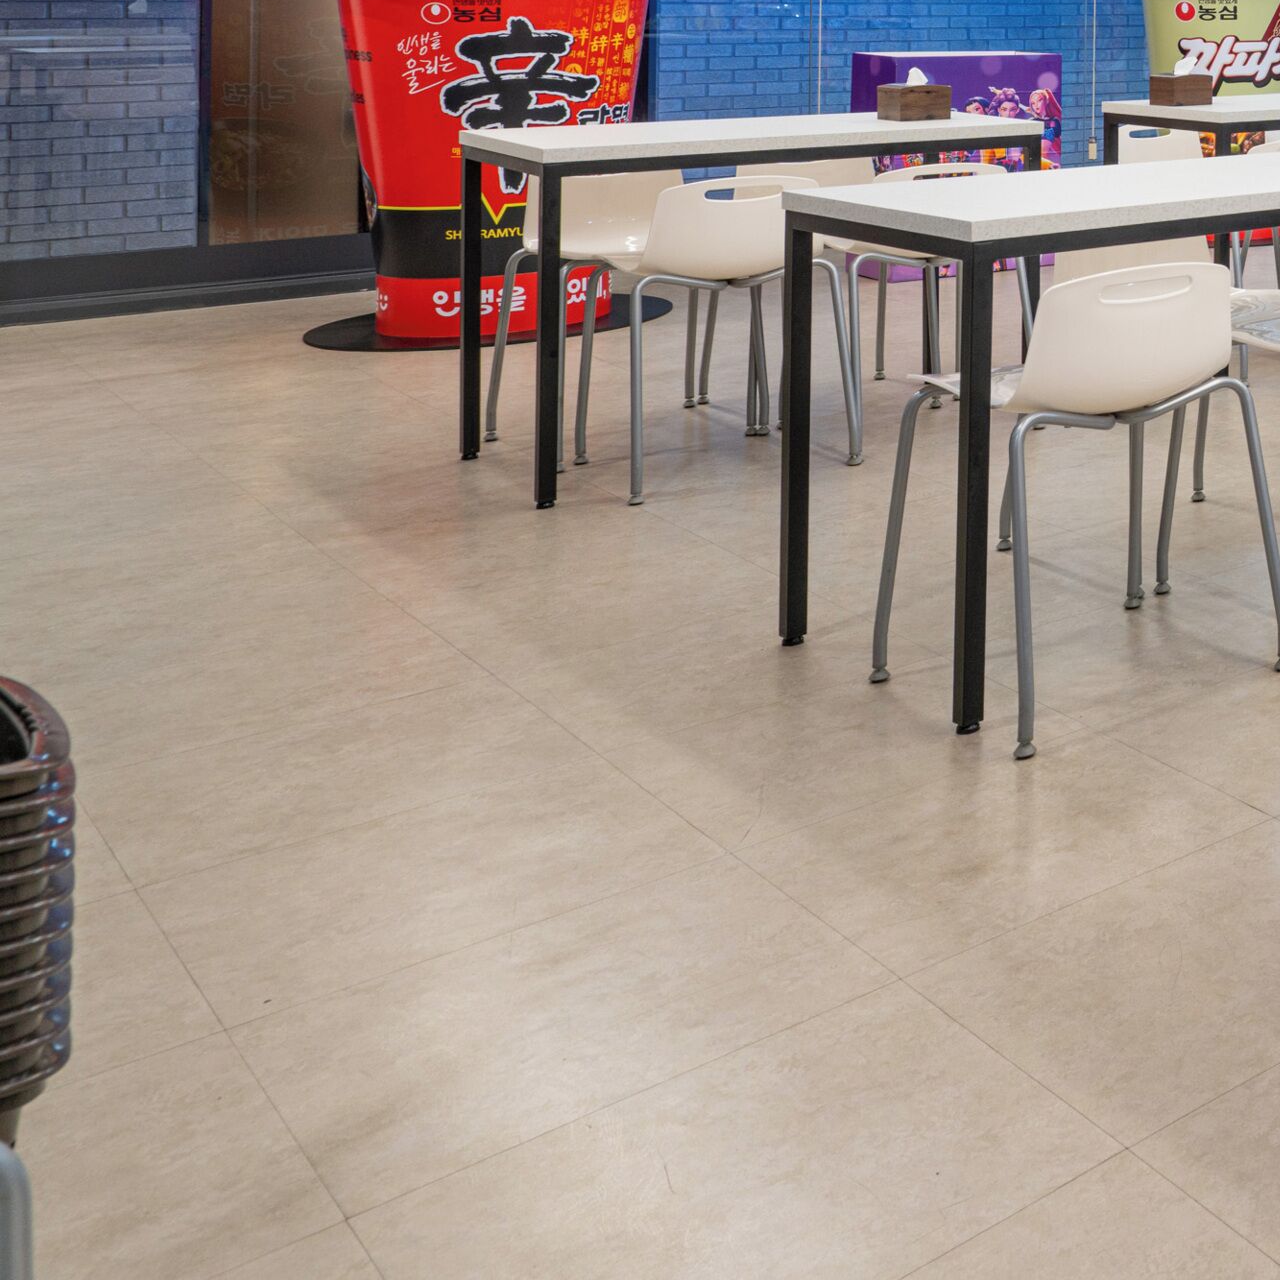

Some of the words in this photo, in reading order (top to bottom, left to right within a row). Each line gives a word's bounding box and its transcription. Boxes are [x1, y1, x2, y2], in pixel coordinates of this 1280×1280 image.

[453, 7, 501, 22] 농심
[1198, 5, 1237, 21] 농심
[397, 31, 443, 56] 인생을
[401, 56, 457, 94] 울리는
